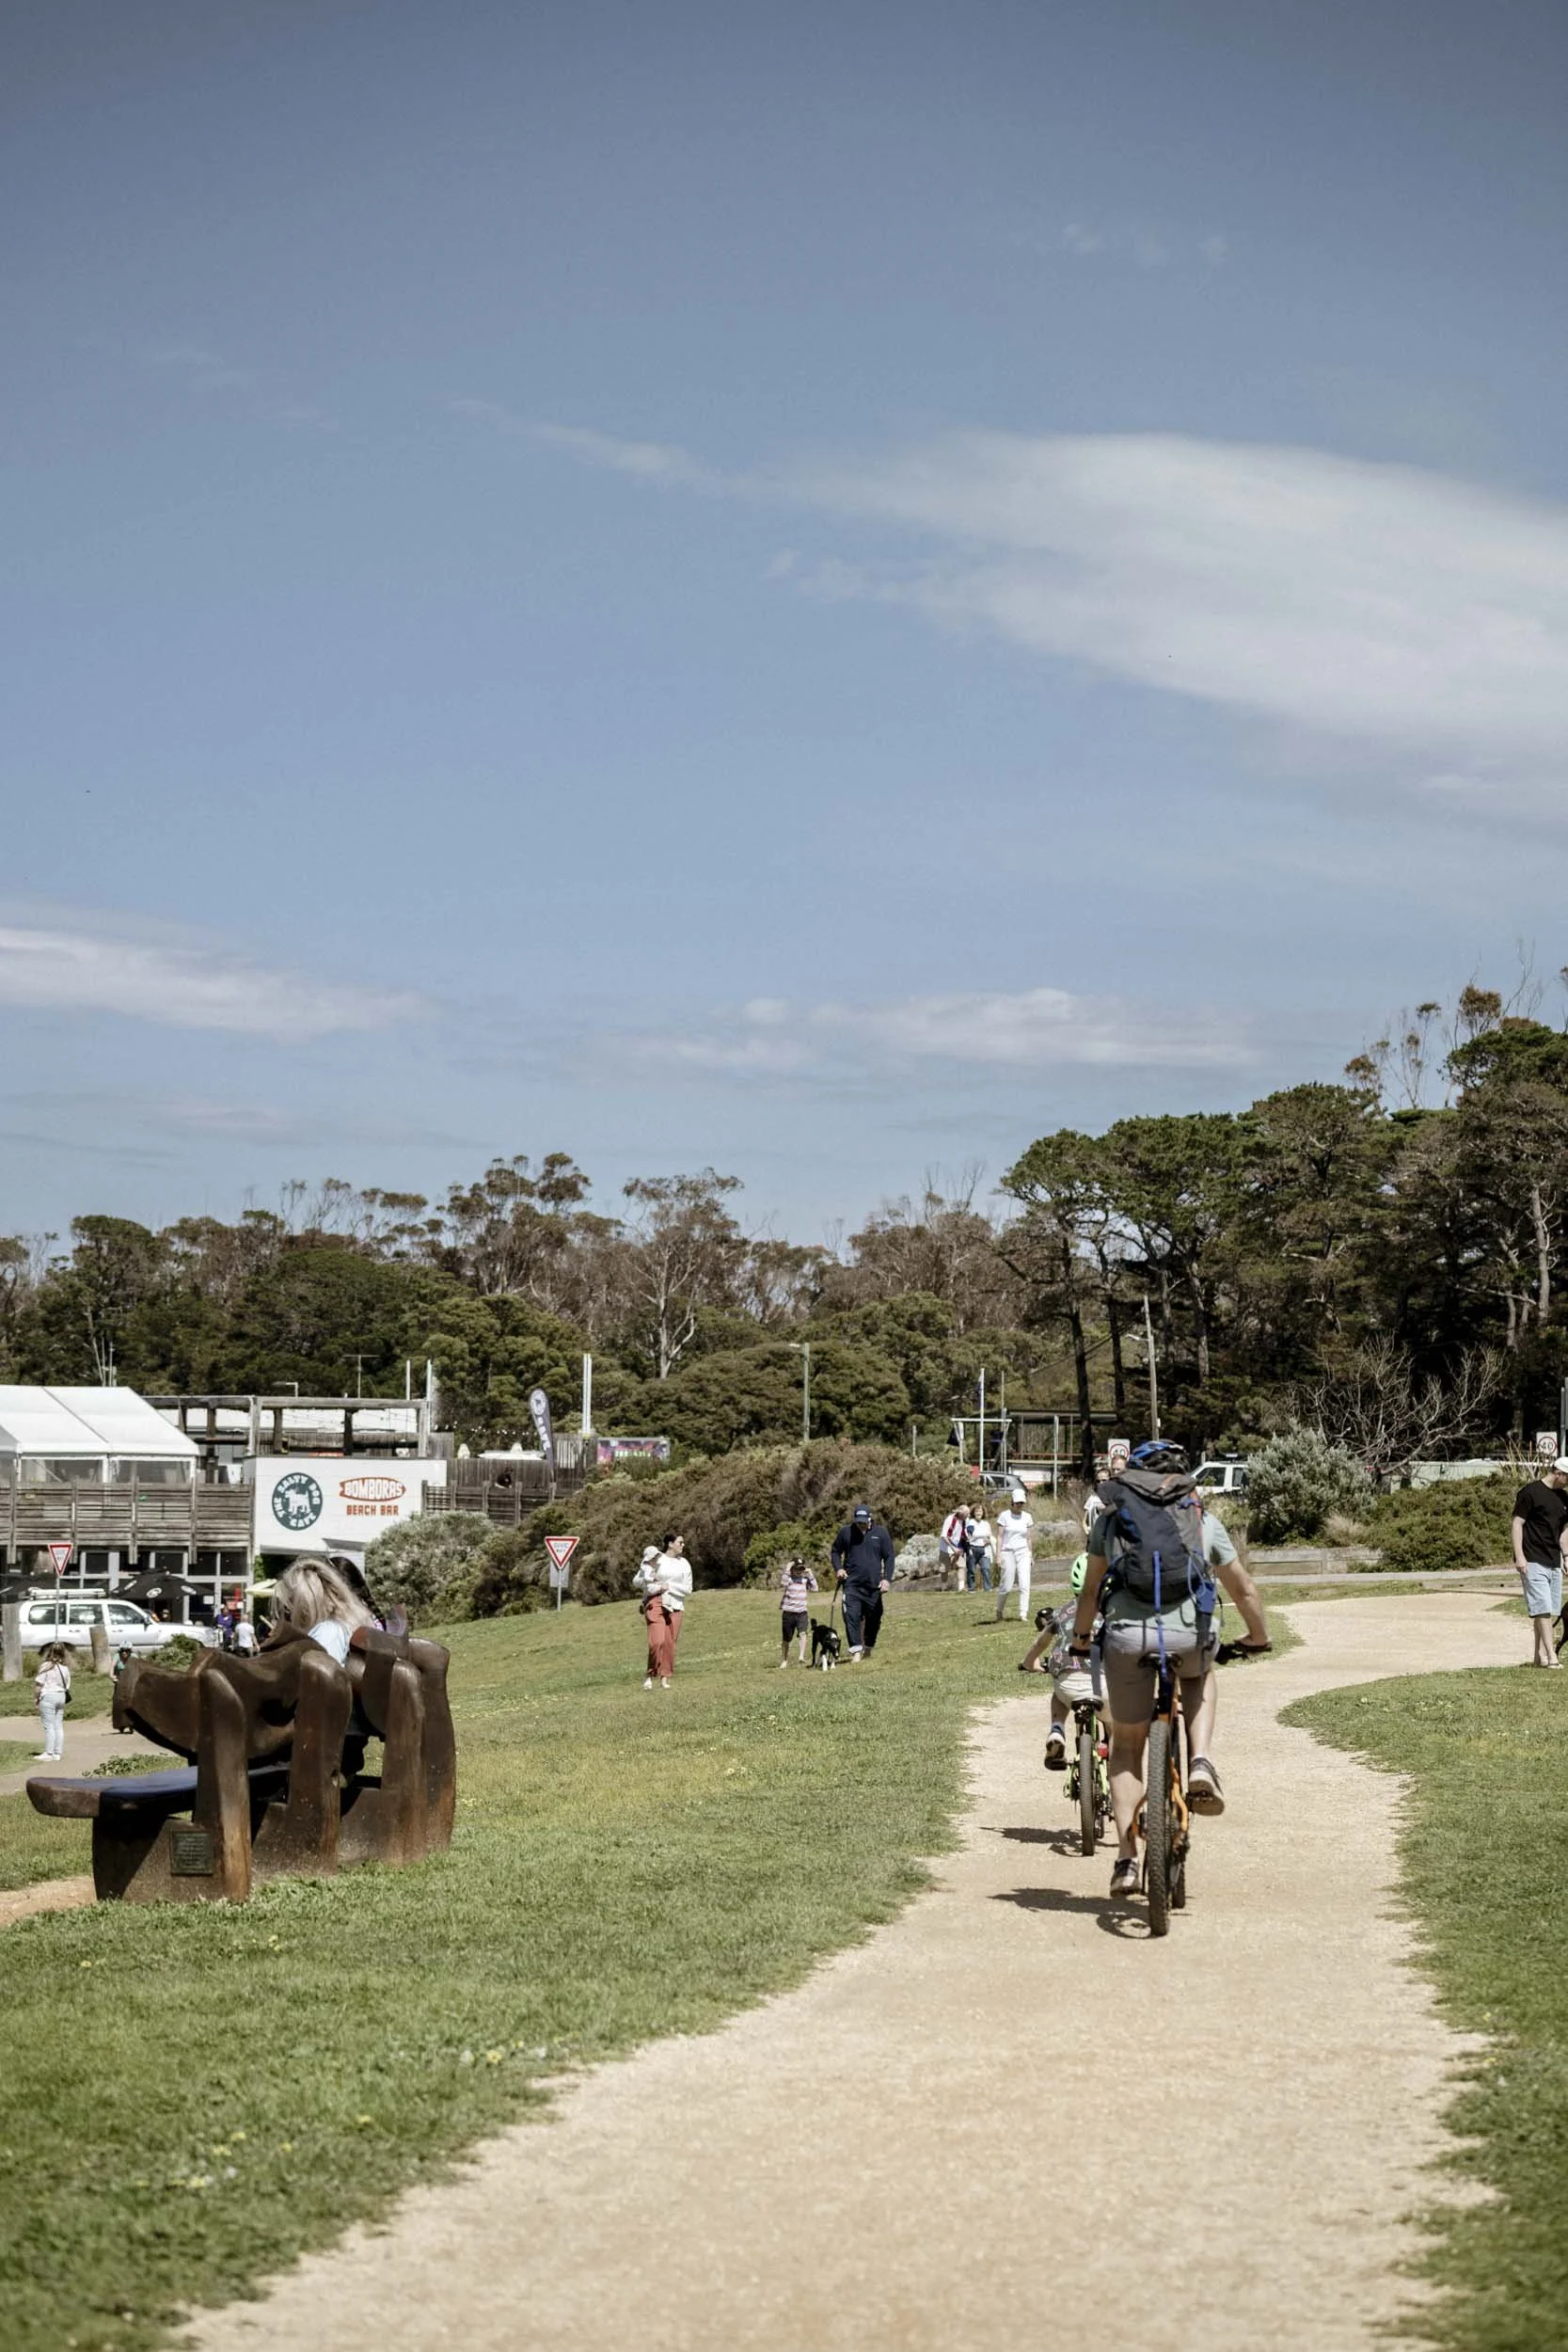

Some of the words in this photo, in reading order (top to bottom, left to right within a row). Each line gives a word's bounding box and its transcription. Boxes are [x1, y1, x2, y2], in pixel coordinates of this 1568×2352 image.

[1541, 1440, 1554, 1451] 40
[277, 1474, 309, 1494] SALTY
[308, 1482, 321, 1505] DOG
[344, 1478, 403, 1501] BOMBORAS
[274, 1497, 286, 1518] THE
[346, 1504, 376, 1517] BEACH
[380, 1504, 399, 1517] BAR
[289, 1512, 317, 1528] CAFE
